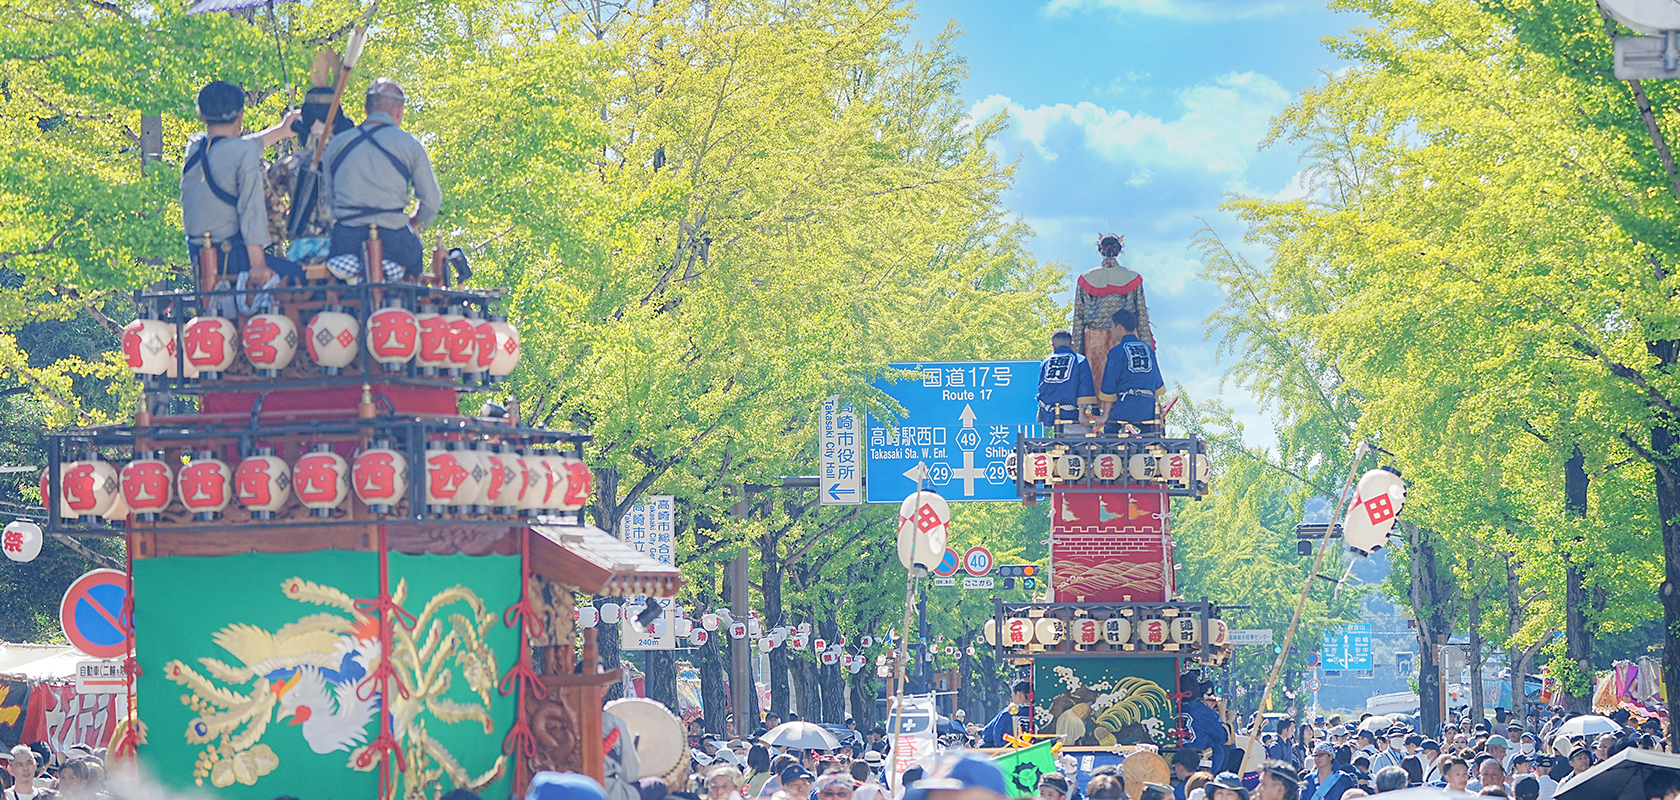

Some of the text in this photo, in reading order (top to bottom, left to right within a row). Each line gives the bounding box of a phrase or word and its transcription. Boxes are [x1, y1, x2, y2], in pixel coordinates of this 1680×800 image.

[184, 320, 224, 366] 西
[242, 318, 280, 364] 宮
[371, 310, 417, 357] 西
[922, 366, 1013, 388] 国道17号
[943, 389, 993, 401] Route 17
[824, 400, 835, 479] Takasaki City Hall
[871, 426, 947, 447] 高崎駅西口
[961, 433, 976, 446] 49
[871, 448, 948, 460] Takasaki Sta. W. Ent.
[985, 446, 1014, 458] Shibu
[235, 459, 270, 505] 西
[295, 456, 338, 503] 西
[354, 452, 396, 499] 西
[933, 467, 948, 480] 29
[990, 467, 1005, 480] 29
[122, 462, 169, 508] 西
[180, 462, 225, 508] 西
[4, 530, 24, 553] 祭
[649, 533, 657, 545] City
[970, 554, 987, 568] 40
